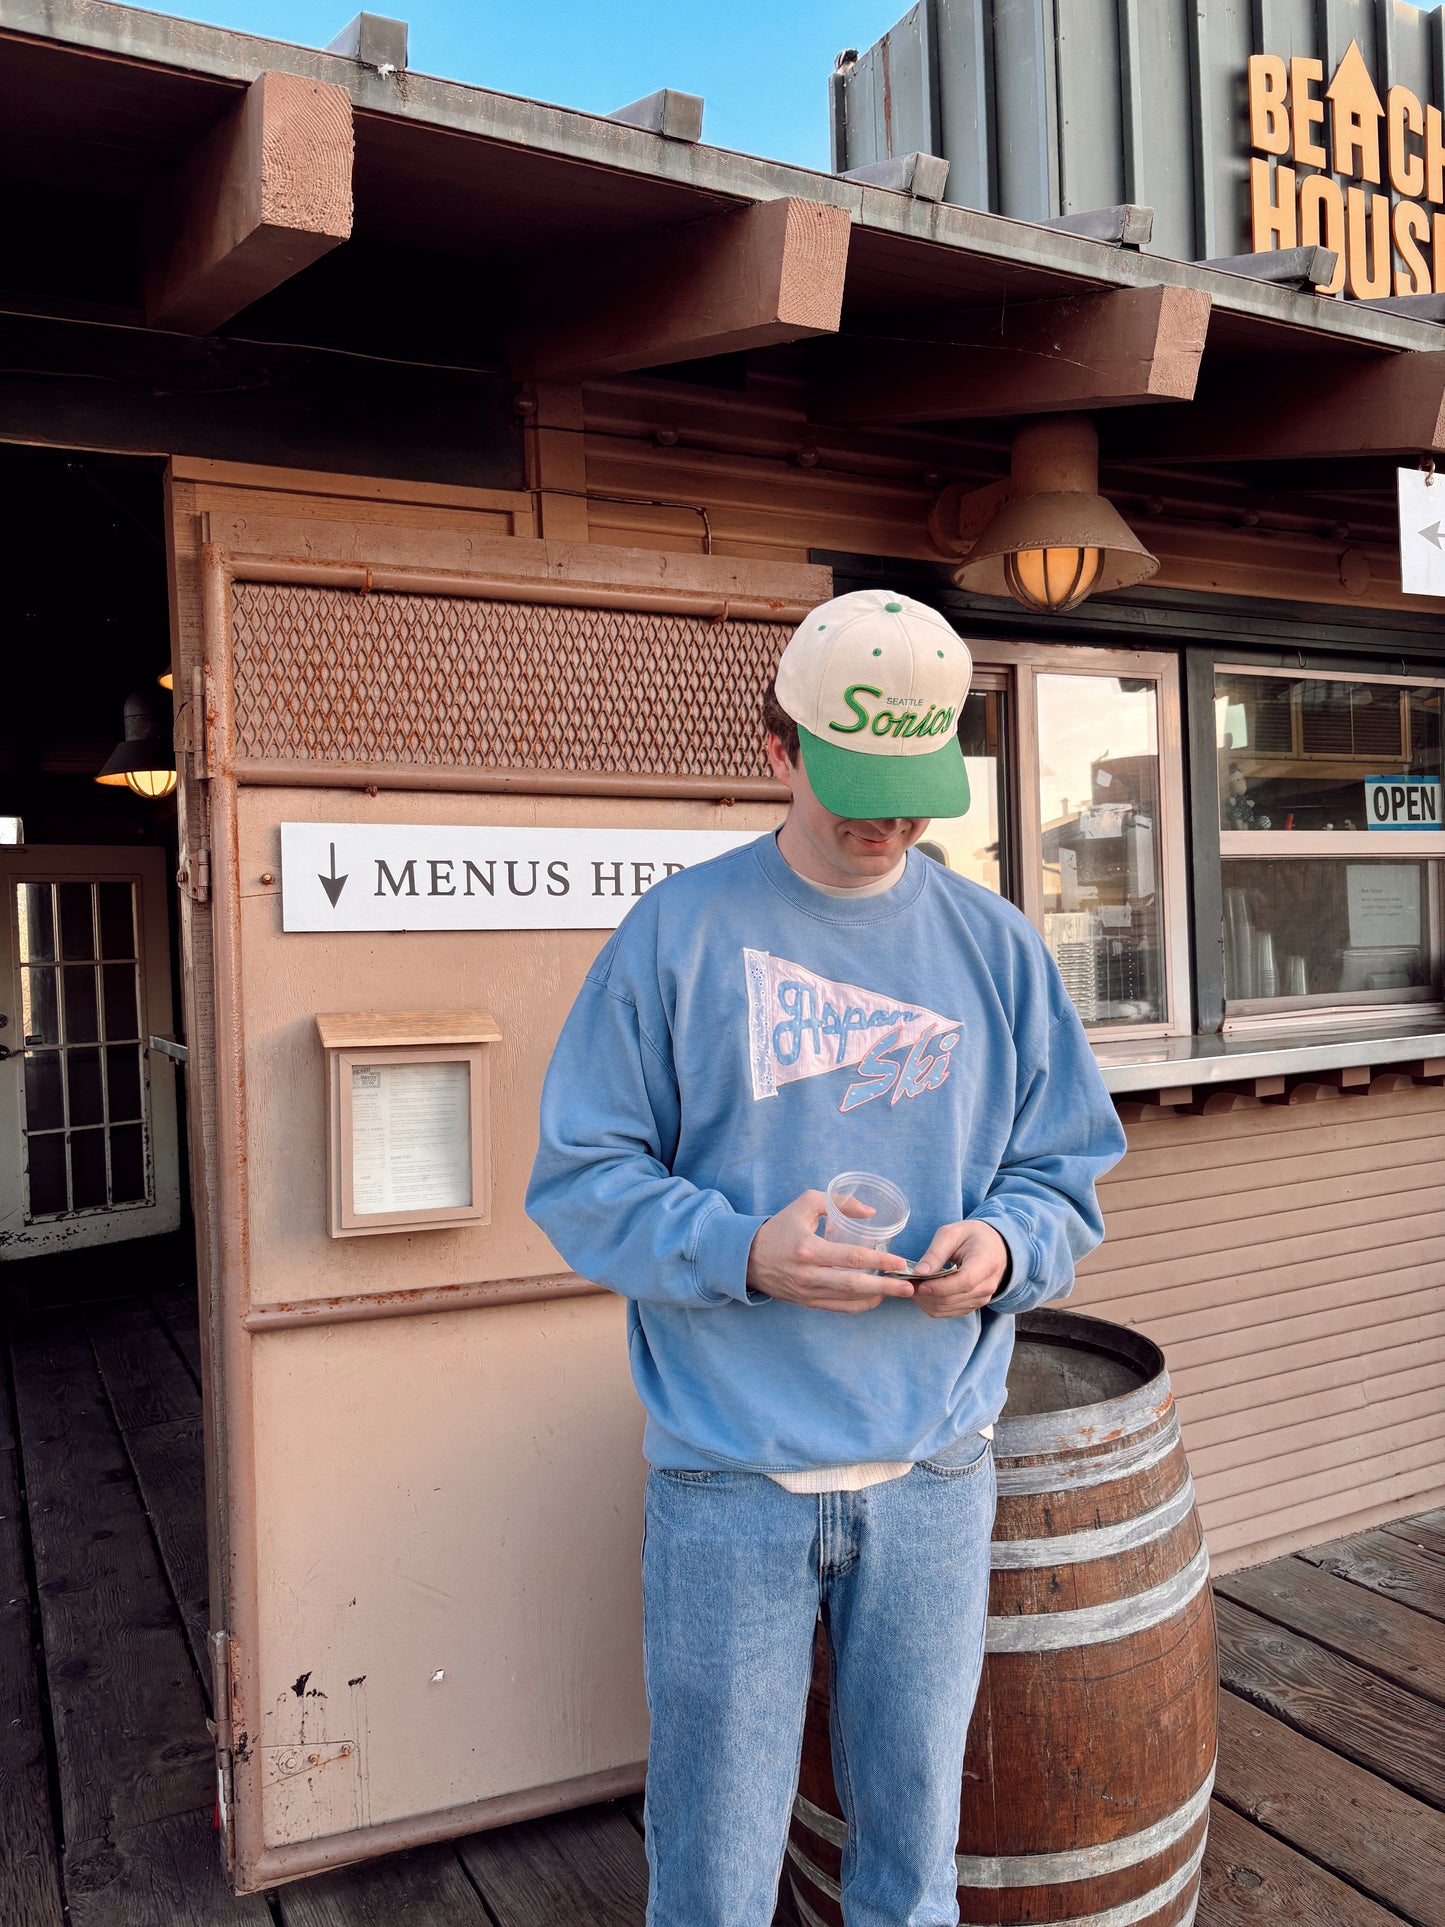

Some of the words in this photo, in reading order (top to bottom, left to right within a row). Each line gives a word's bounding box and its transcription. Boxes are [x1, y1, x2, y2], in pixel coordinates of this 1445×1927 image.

[886, 697, 924, 707] SEATTLE
[1373, 786, 1436, 822] OPEN
[374, 859, 571, 897] MENUS
